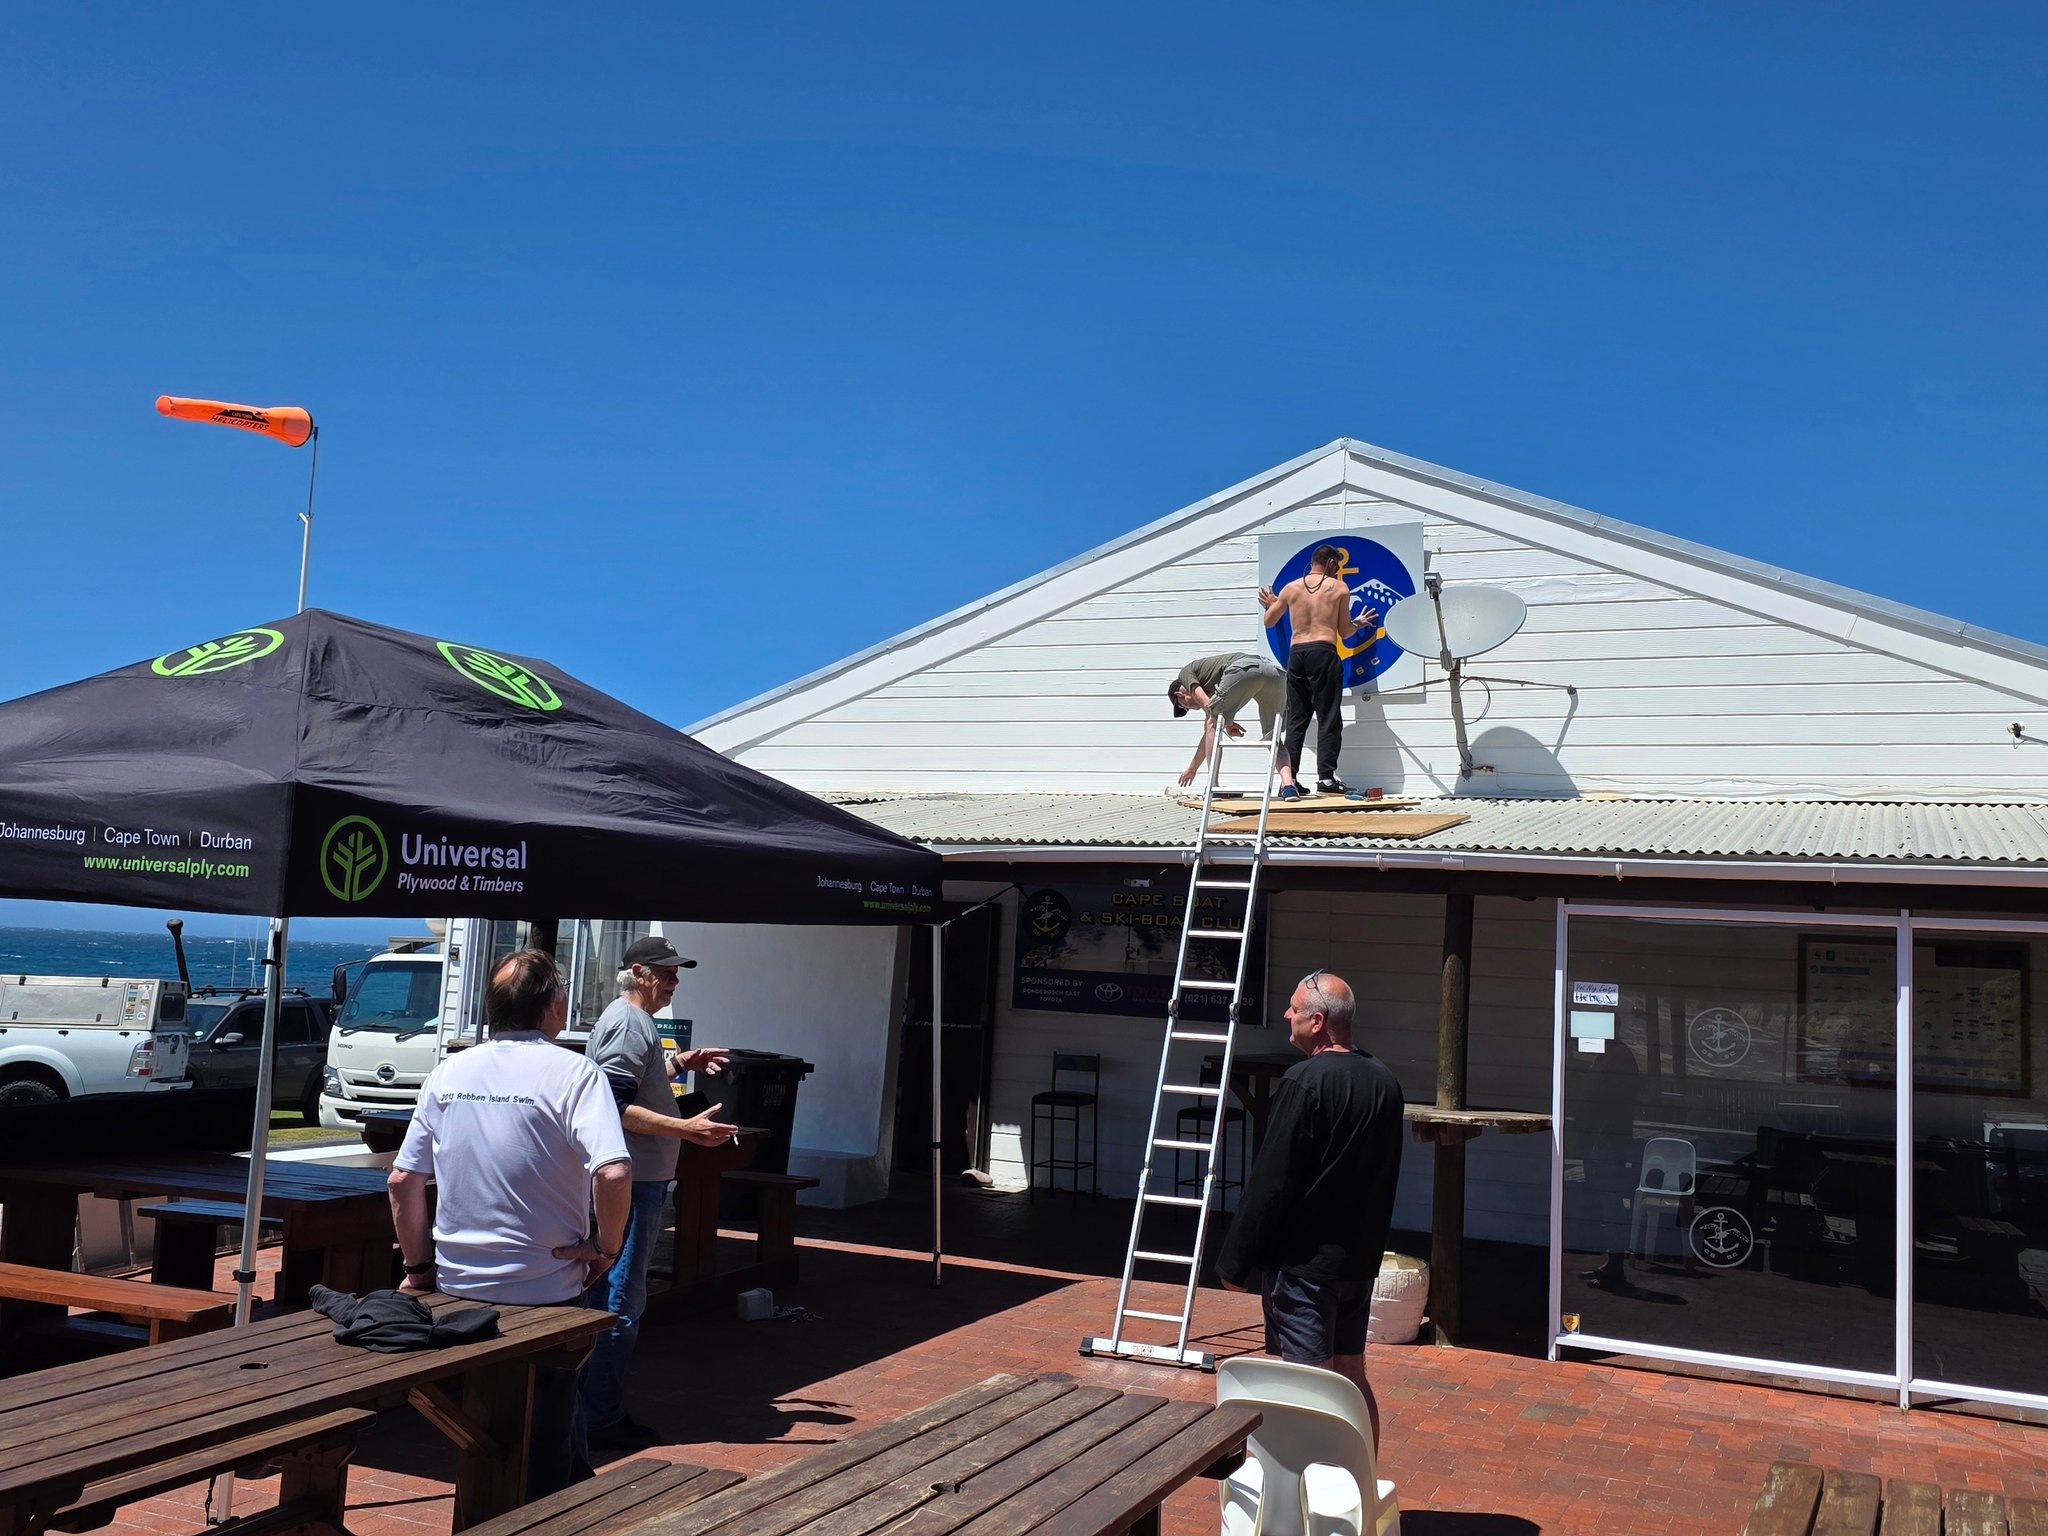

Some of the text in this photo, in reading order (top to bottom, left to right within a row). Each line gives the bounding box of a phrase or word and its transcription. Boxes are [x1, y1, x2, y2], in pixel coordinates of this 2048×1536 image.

[209, 414, 270, 431] HELICOPTERS
[0, 821, 252, 850] Johannesburg Cape Town Durban
[401, 832, 527, 870] Universal
[83, 855, 250, 878] www.universalply.com
[398, 873, 524, 894] Plywood & Timbers
[816, 875, 933, 897] Johannesburg Cape Town Durban
[1112, 893, 1164, 907] CAPE
[1080, 911, 1093, 923] &
[1102, 911, 1187, 927] SKI-BOA
[1021, 976, 1084, 988] SPONSORED BY
[1184, 993, 1208, 1006] (021)
[456, 1092, 486, 1102] Robben
[488, 1094, 510, 1103] Island
[512, 1096, 535, 1106] Swim
